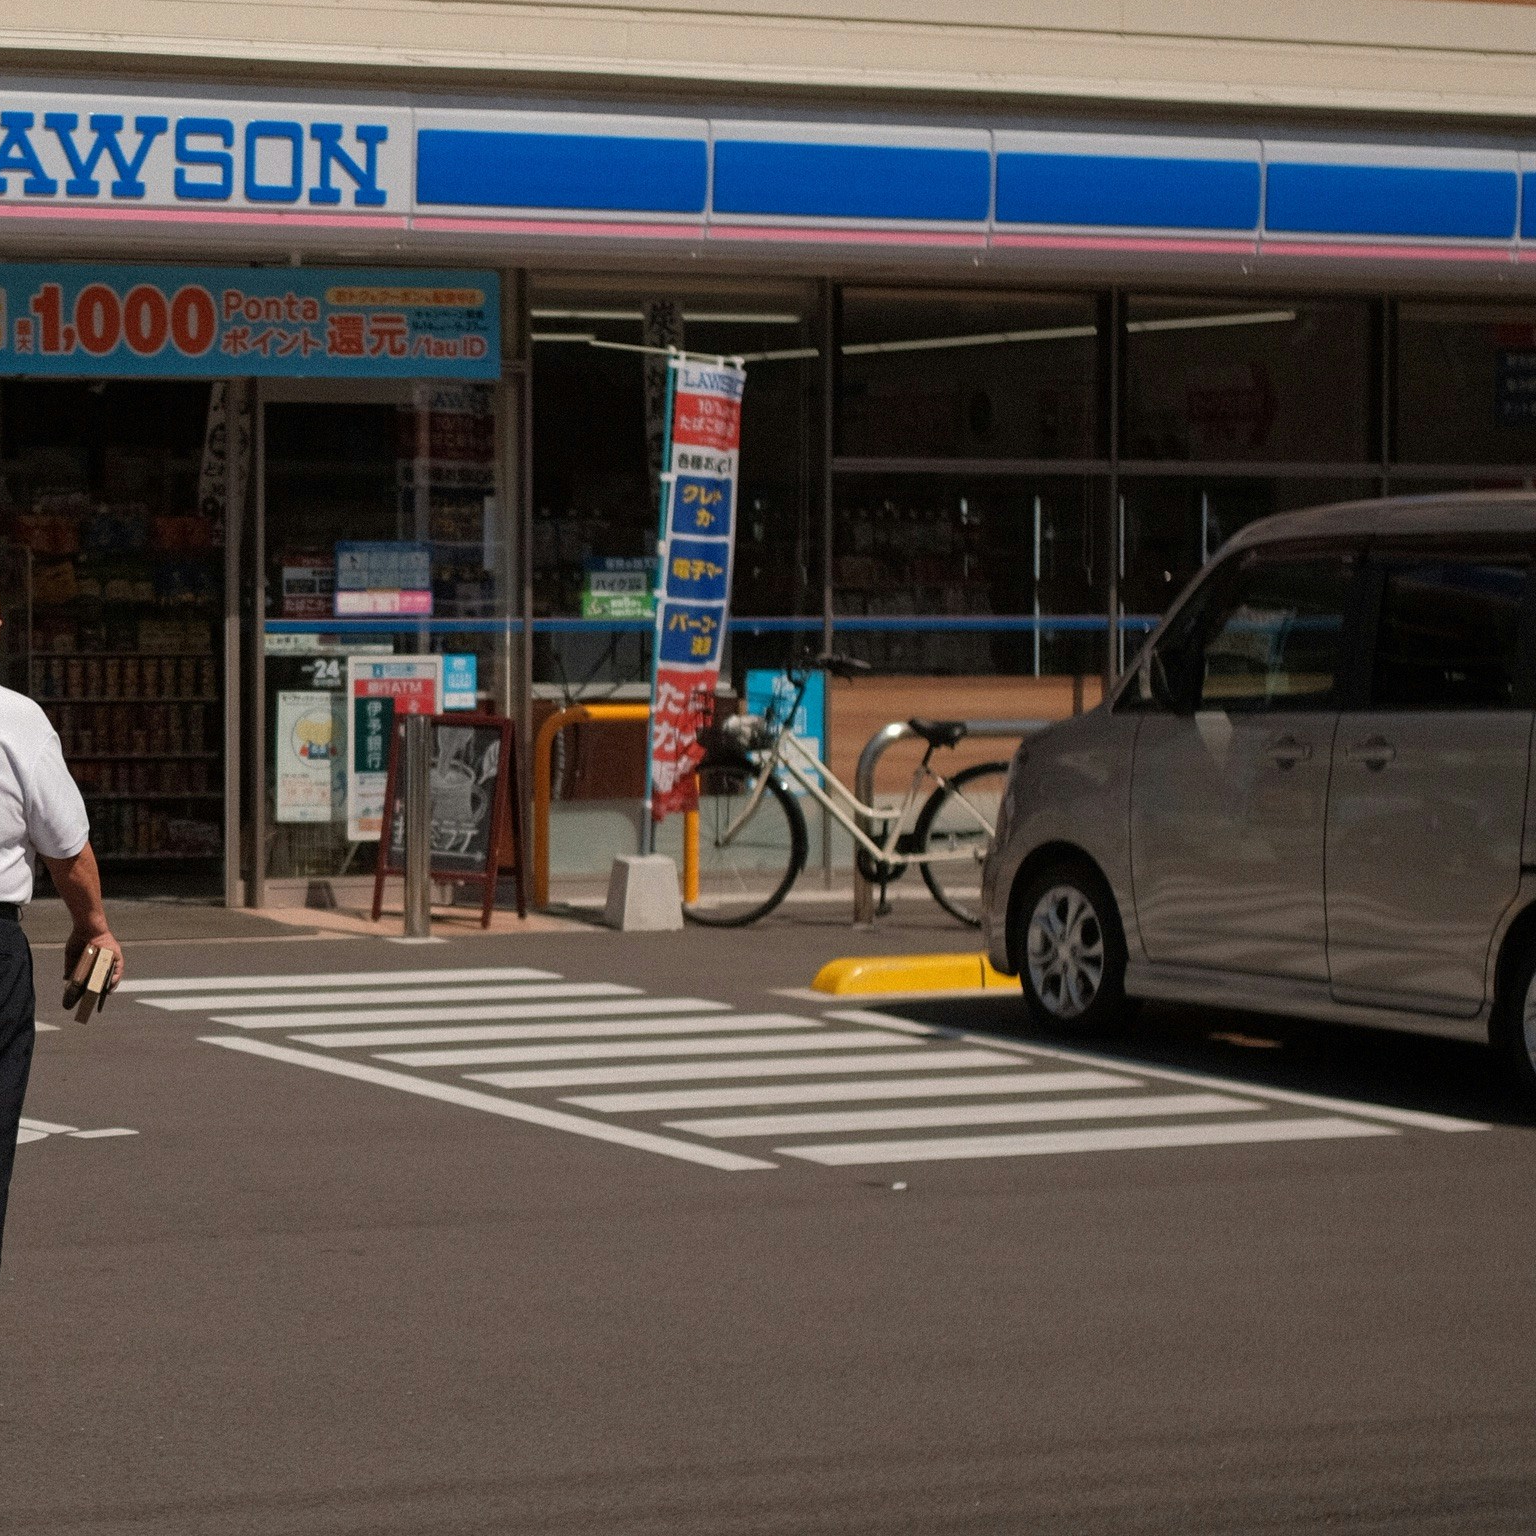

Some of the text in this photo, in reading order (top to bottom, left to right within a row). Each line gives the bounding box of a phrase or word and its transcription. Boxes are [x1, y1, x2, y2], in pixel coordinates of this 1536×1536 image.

[31, 283, 218, 356] 1,000
[222, 289, 320, 323] Ponta
[221, 327, 321, 356] ポイント
[326, 313, 409, 358] 還元
